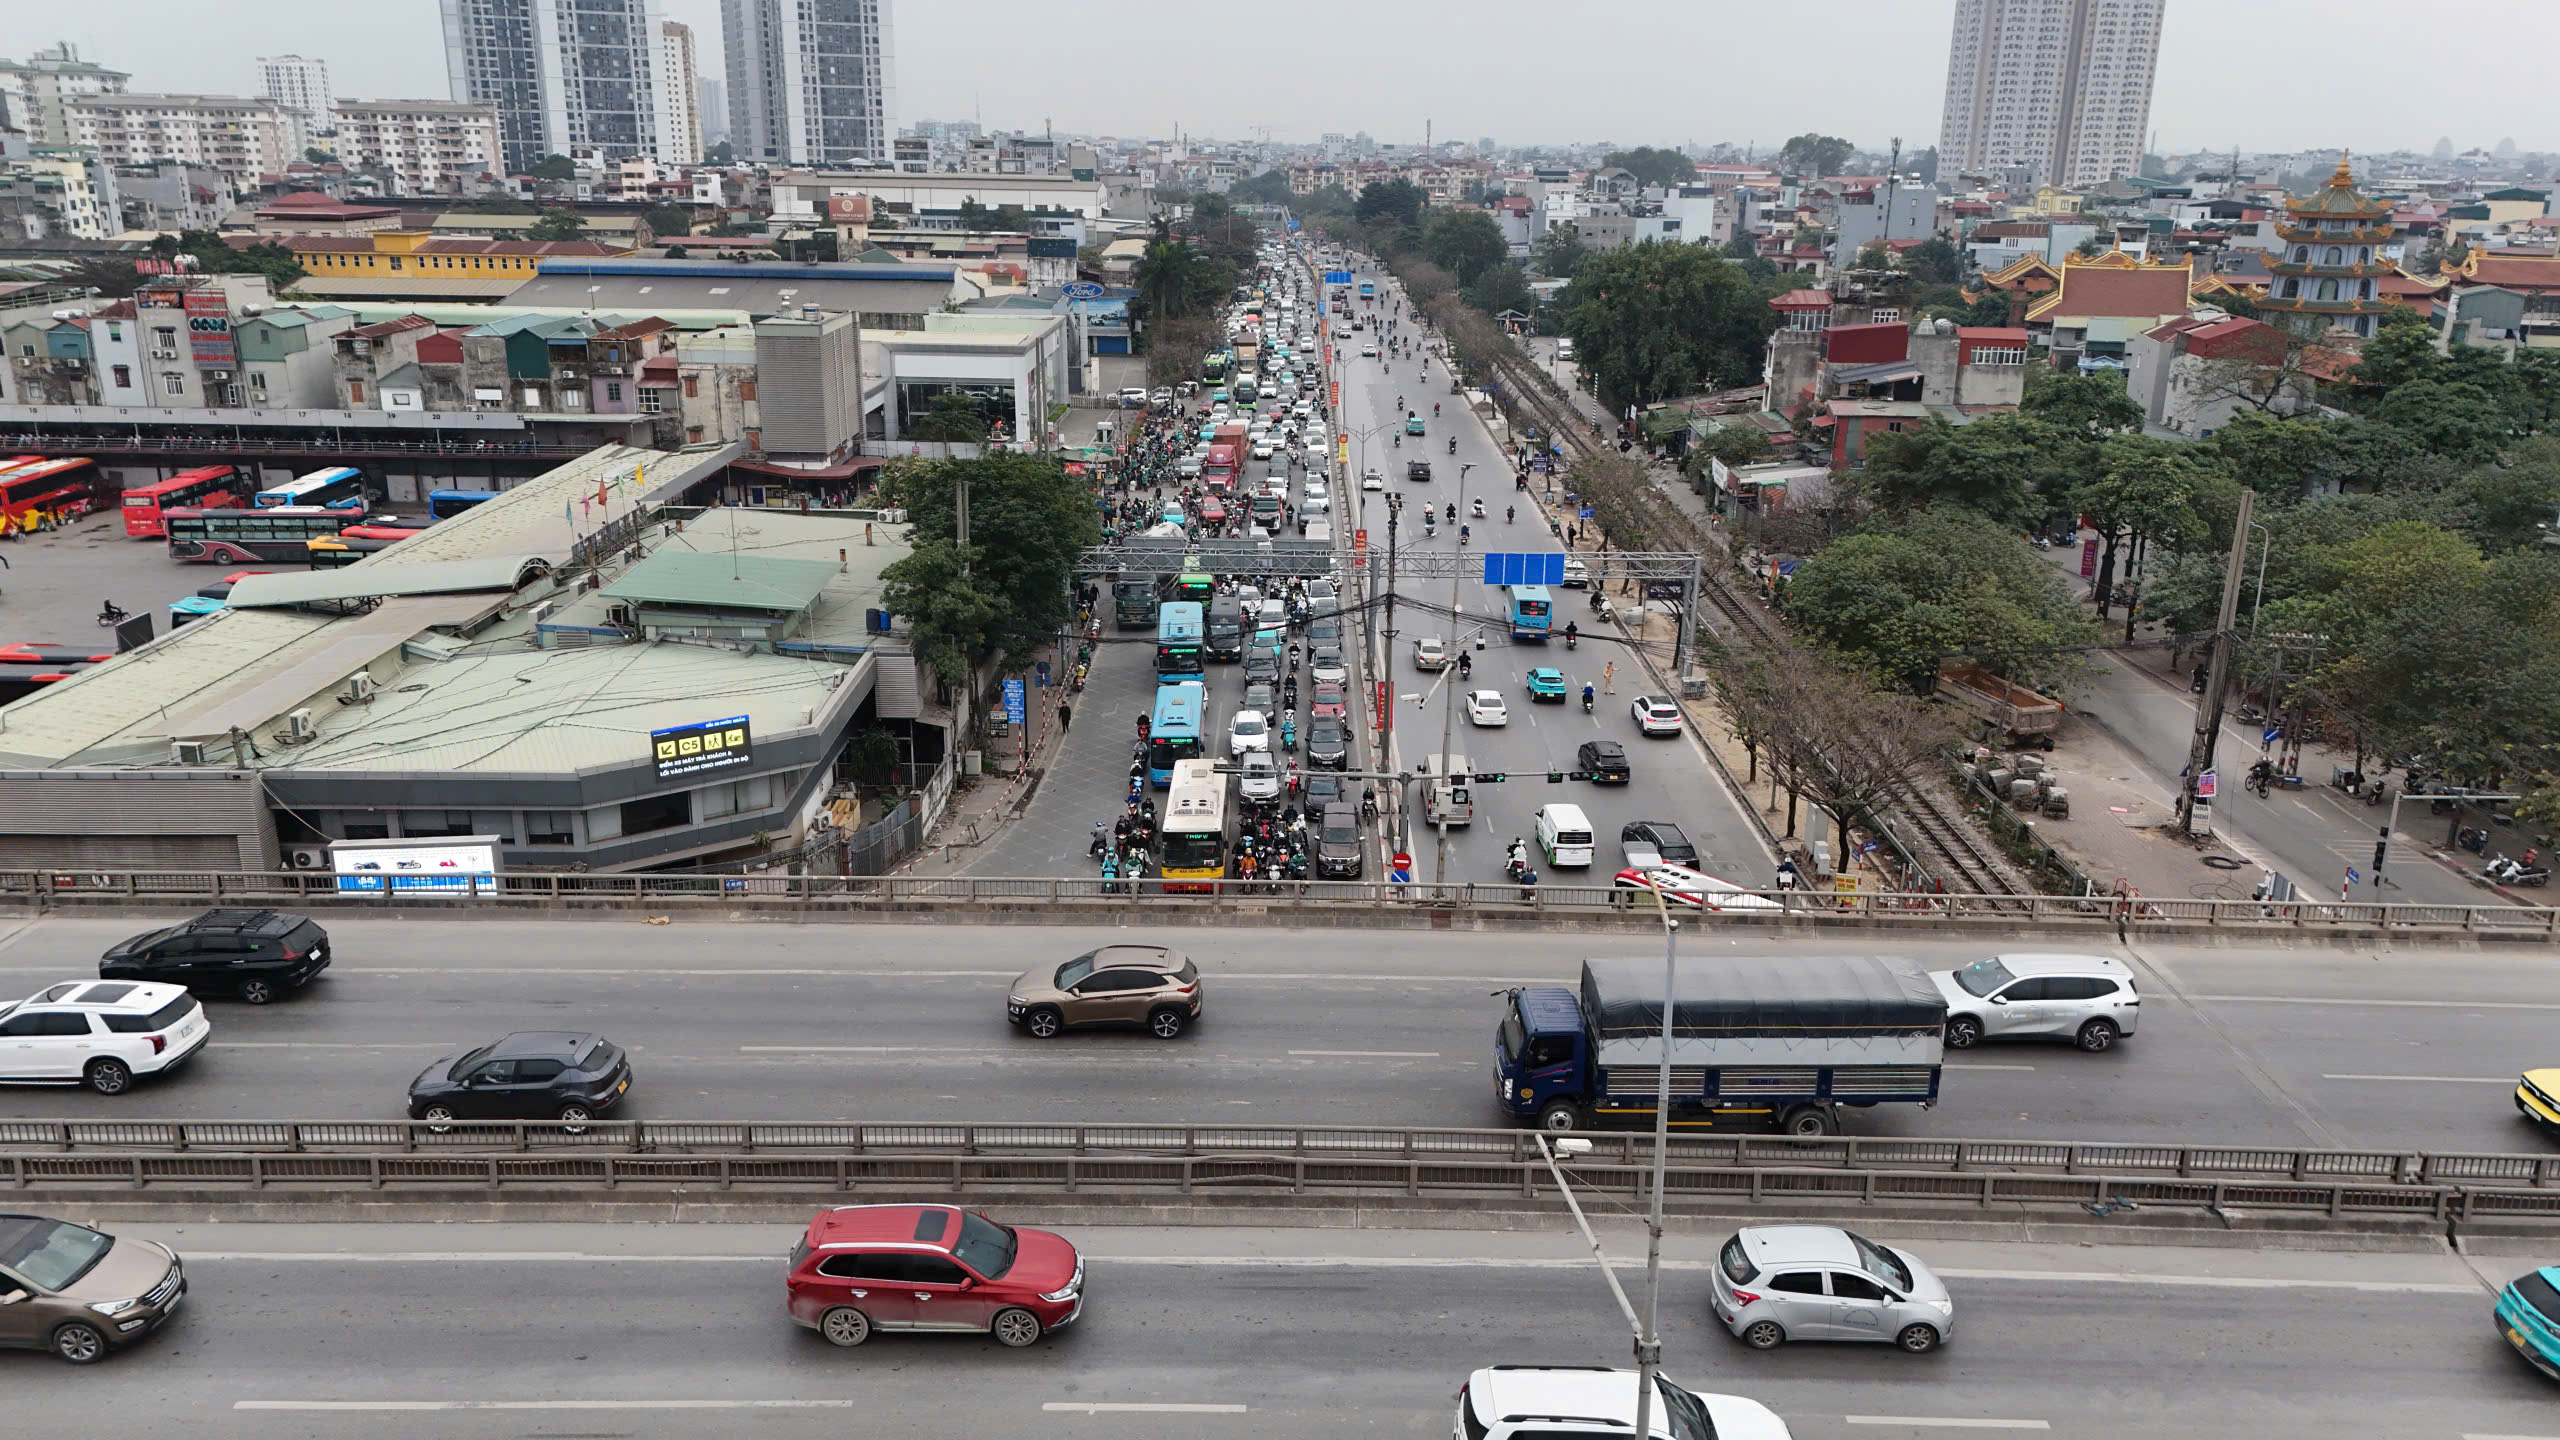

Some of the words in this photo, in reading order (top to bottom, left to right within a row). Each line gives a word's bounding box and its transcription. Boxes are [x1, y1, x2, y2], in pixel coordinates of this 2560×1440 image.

[1069, 283, 1096, 296] Ford
[681, 740, 698, 751] C5
[670, 767, 684, 775] VÀO
[684, 763, 700, 773] DÀNH
